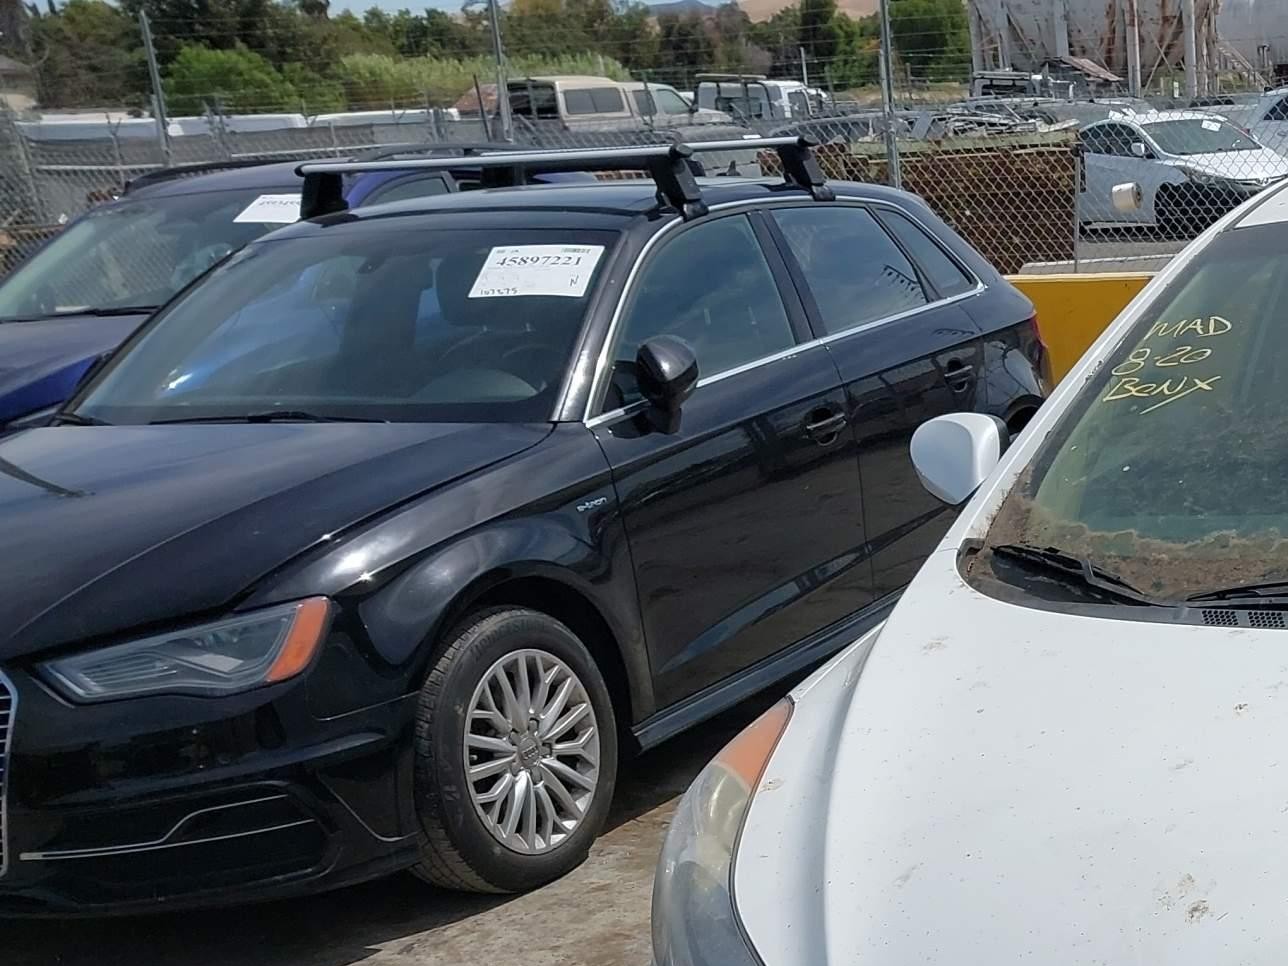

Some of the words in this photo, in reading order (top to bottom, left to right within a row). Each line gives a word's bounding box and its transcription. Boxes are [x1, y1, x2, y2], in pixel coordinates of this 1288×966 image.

[496, 255, 582, 267] 45897221
[1144, 316, 1232, 340] MAD
[1111, 346, 1212, 376] 8-20
